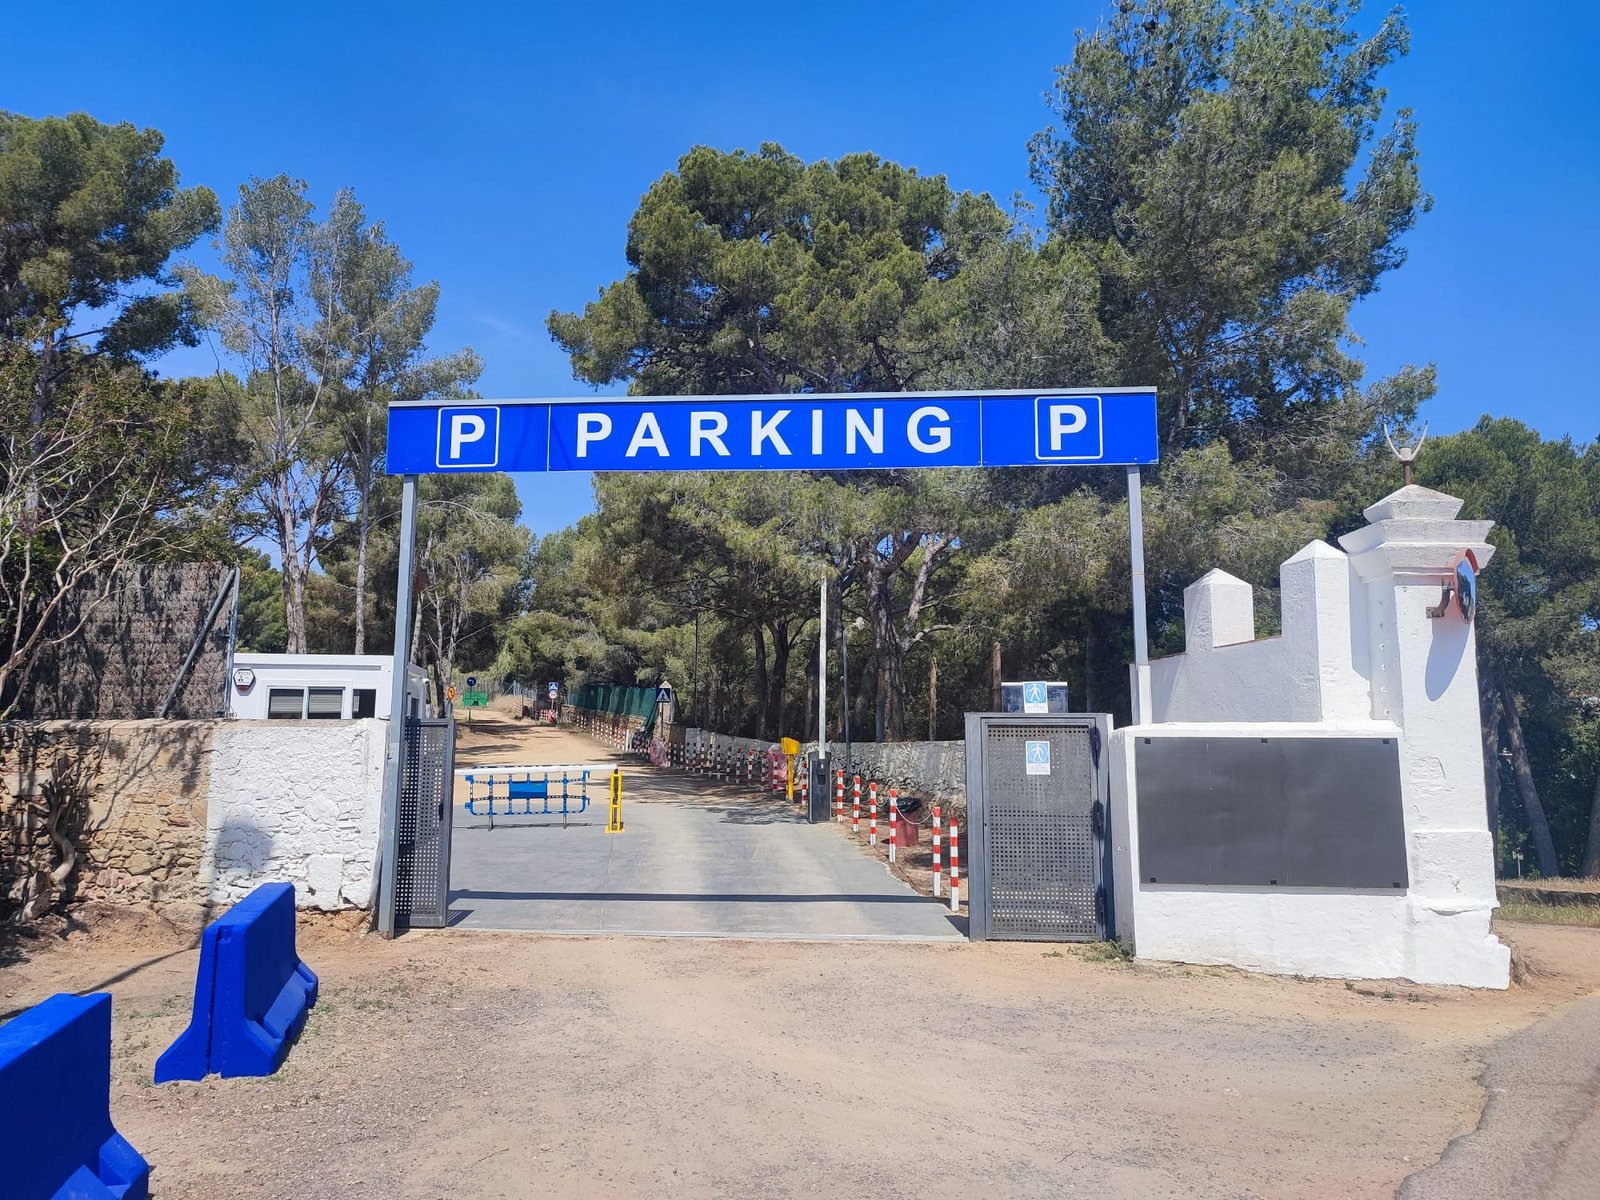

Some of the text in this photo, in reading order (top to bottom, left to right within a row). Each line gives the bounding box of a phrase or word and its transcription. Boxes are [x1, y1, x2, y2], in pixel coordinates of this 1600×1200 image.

[450, 404, 1087, 459] P PARKING P
